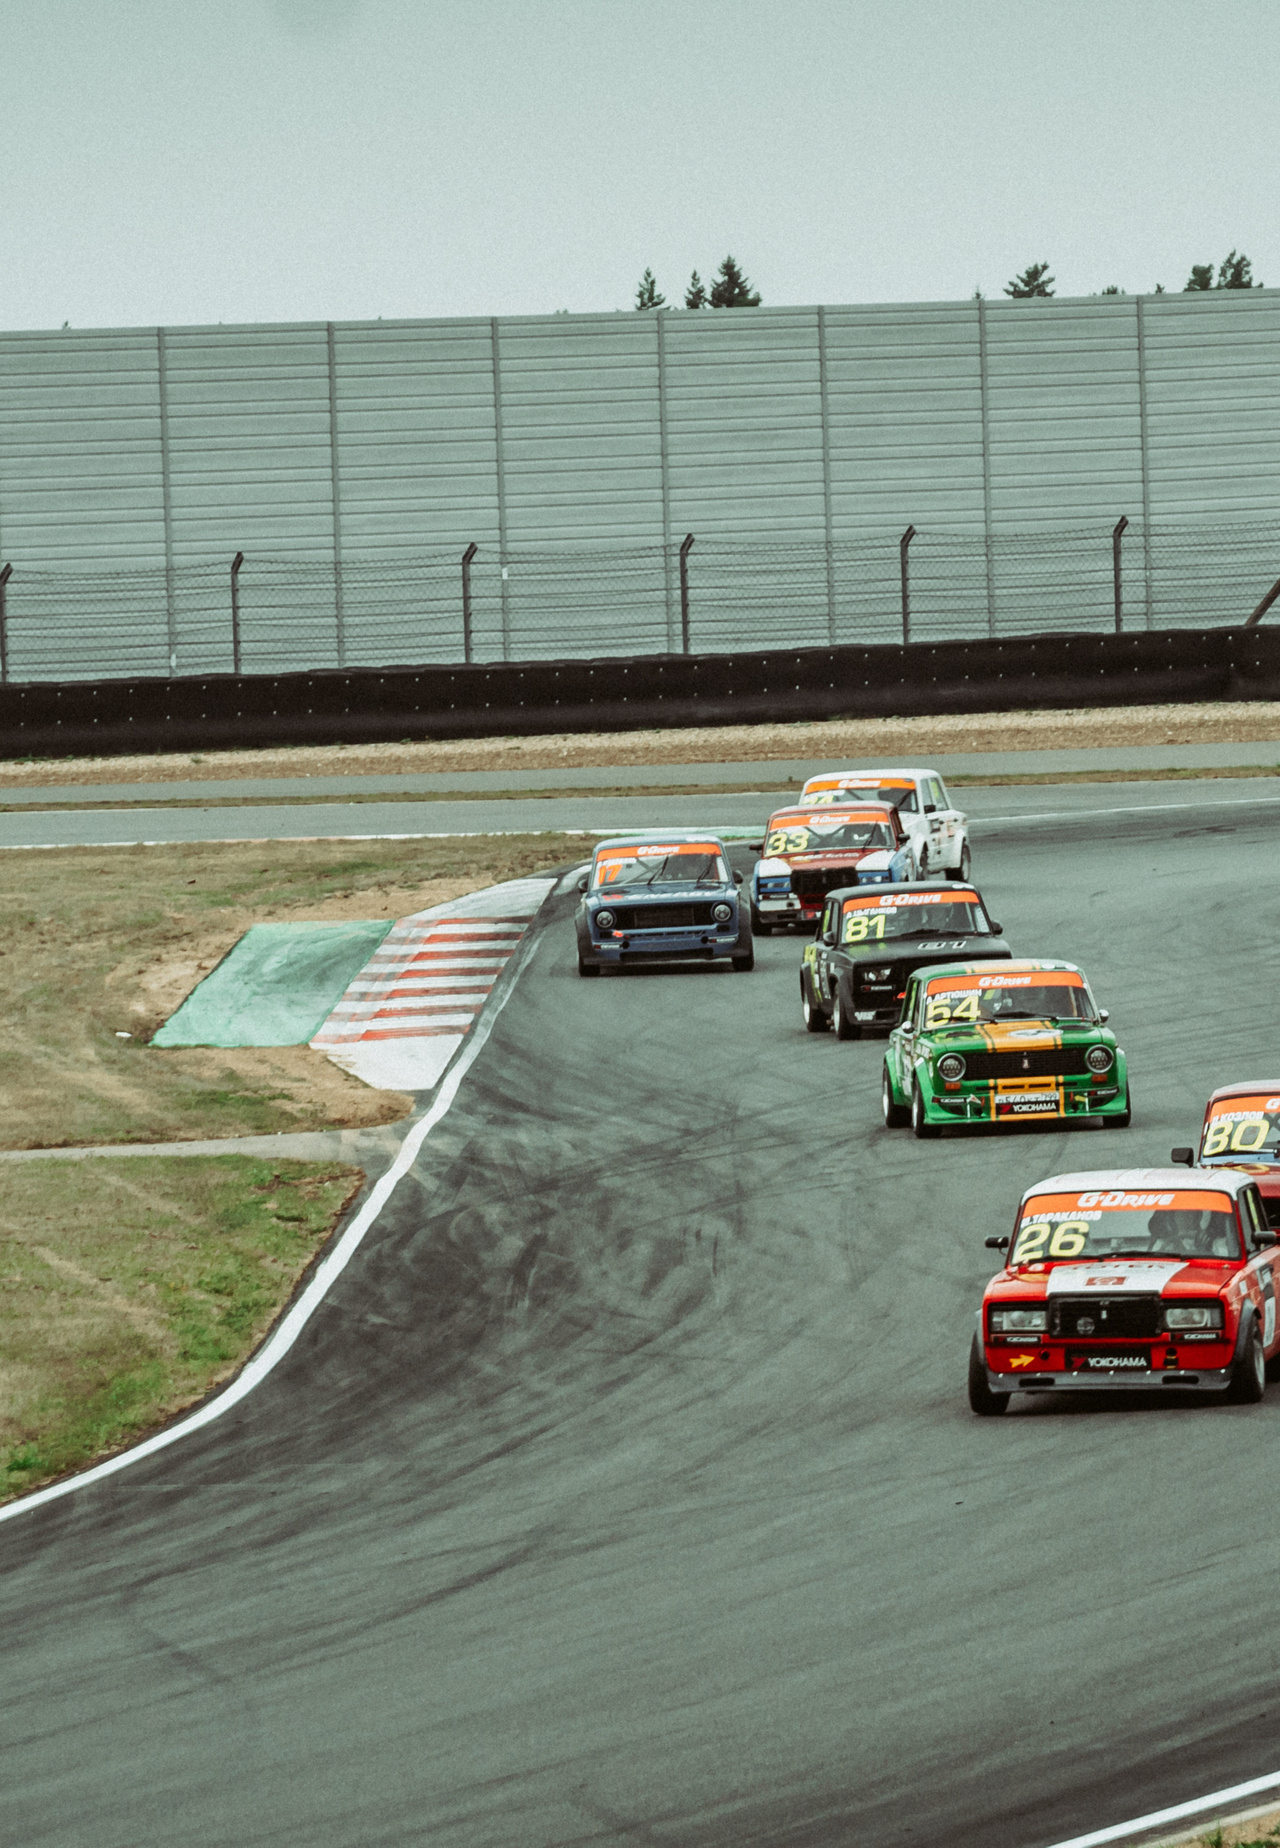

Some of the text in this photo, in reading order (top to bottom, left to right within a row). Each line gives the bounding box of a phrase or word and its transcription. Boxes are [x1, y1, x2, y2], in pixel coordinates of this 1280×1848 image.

[766, 831, 809, 856] 33
[598, 863, 622, 884] 17
[845, 914, 886, 943] 81
[926, 995, 981, 1029] 54
[1013, 1102, 1057, 1112] YOKOHAMA
[1203, 1119, 1270, 1156] 80
[1011, 1221, 1091, 1266] 26
[1087, 1357, 1147, 1368] YOKOHAMA
